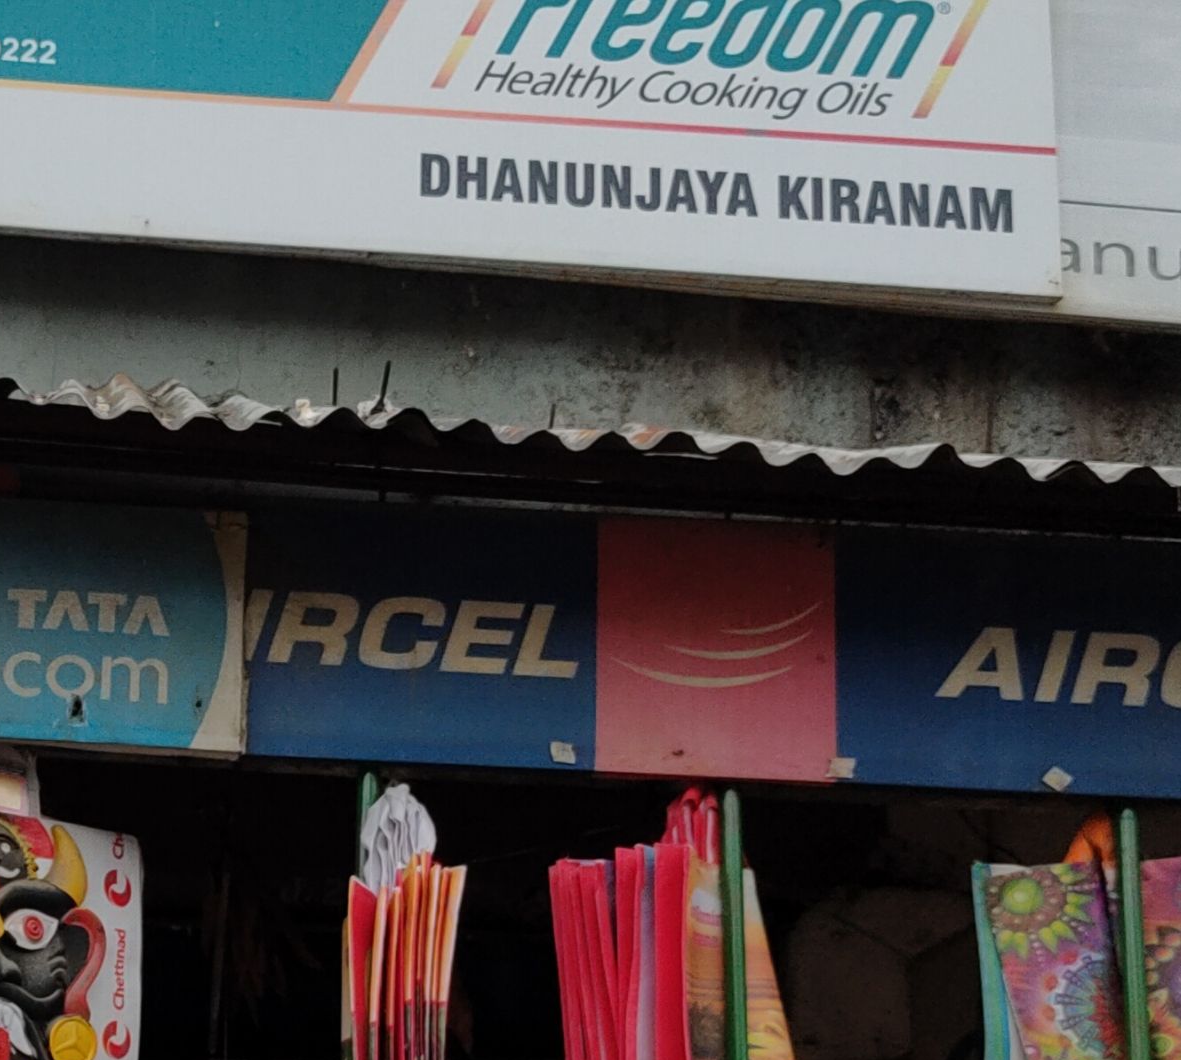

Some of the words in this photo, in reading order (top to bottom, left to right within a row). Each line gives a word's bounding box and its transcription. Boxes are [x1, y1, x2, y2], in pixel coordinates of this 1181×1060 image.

[475, 59, 634, 109] Healthy
[638, 70, 809, 120] Cooking
[816, 80, 893, 119] Oils
[420, 152, 759, 217] DHANUNJAYA
[778, 175, 1014, 234] KIRANAM
[6, 588, 171, 637] TATA
[935, 627, 1181, 709] AIR
[112, 928, 127, 1011] Chettinad
